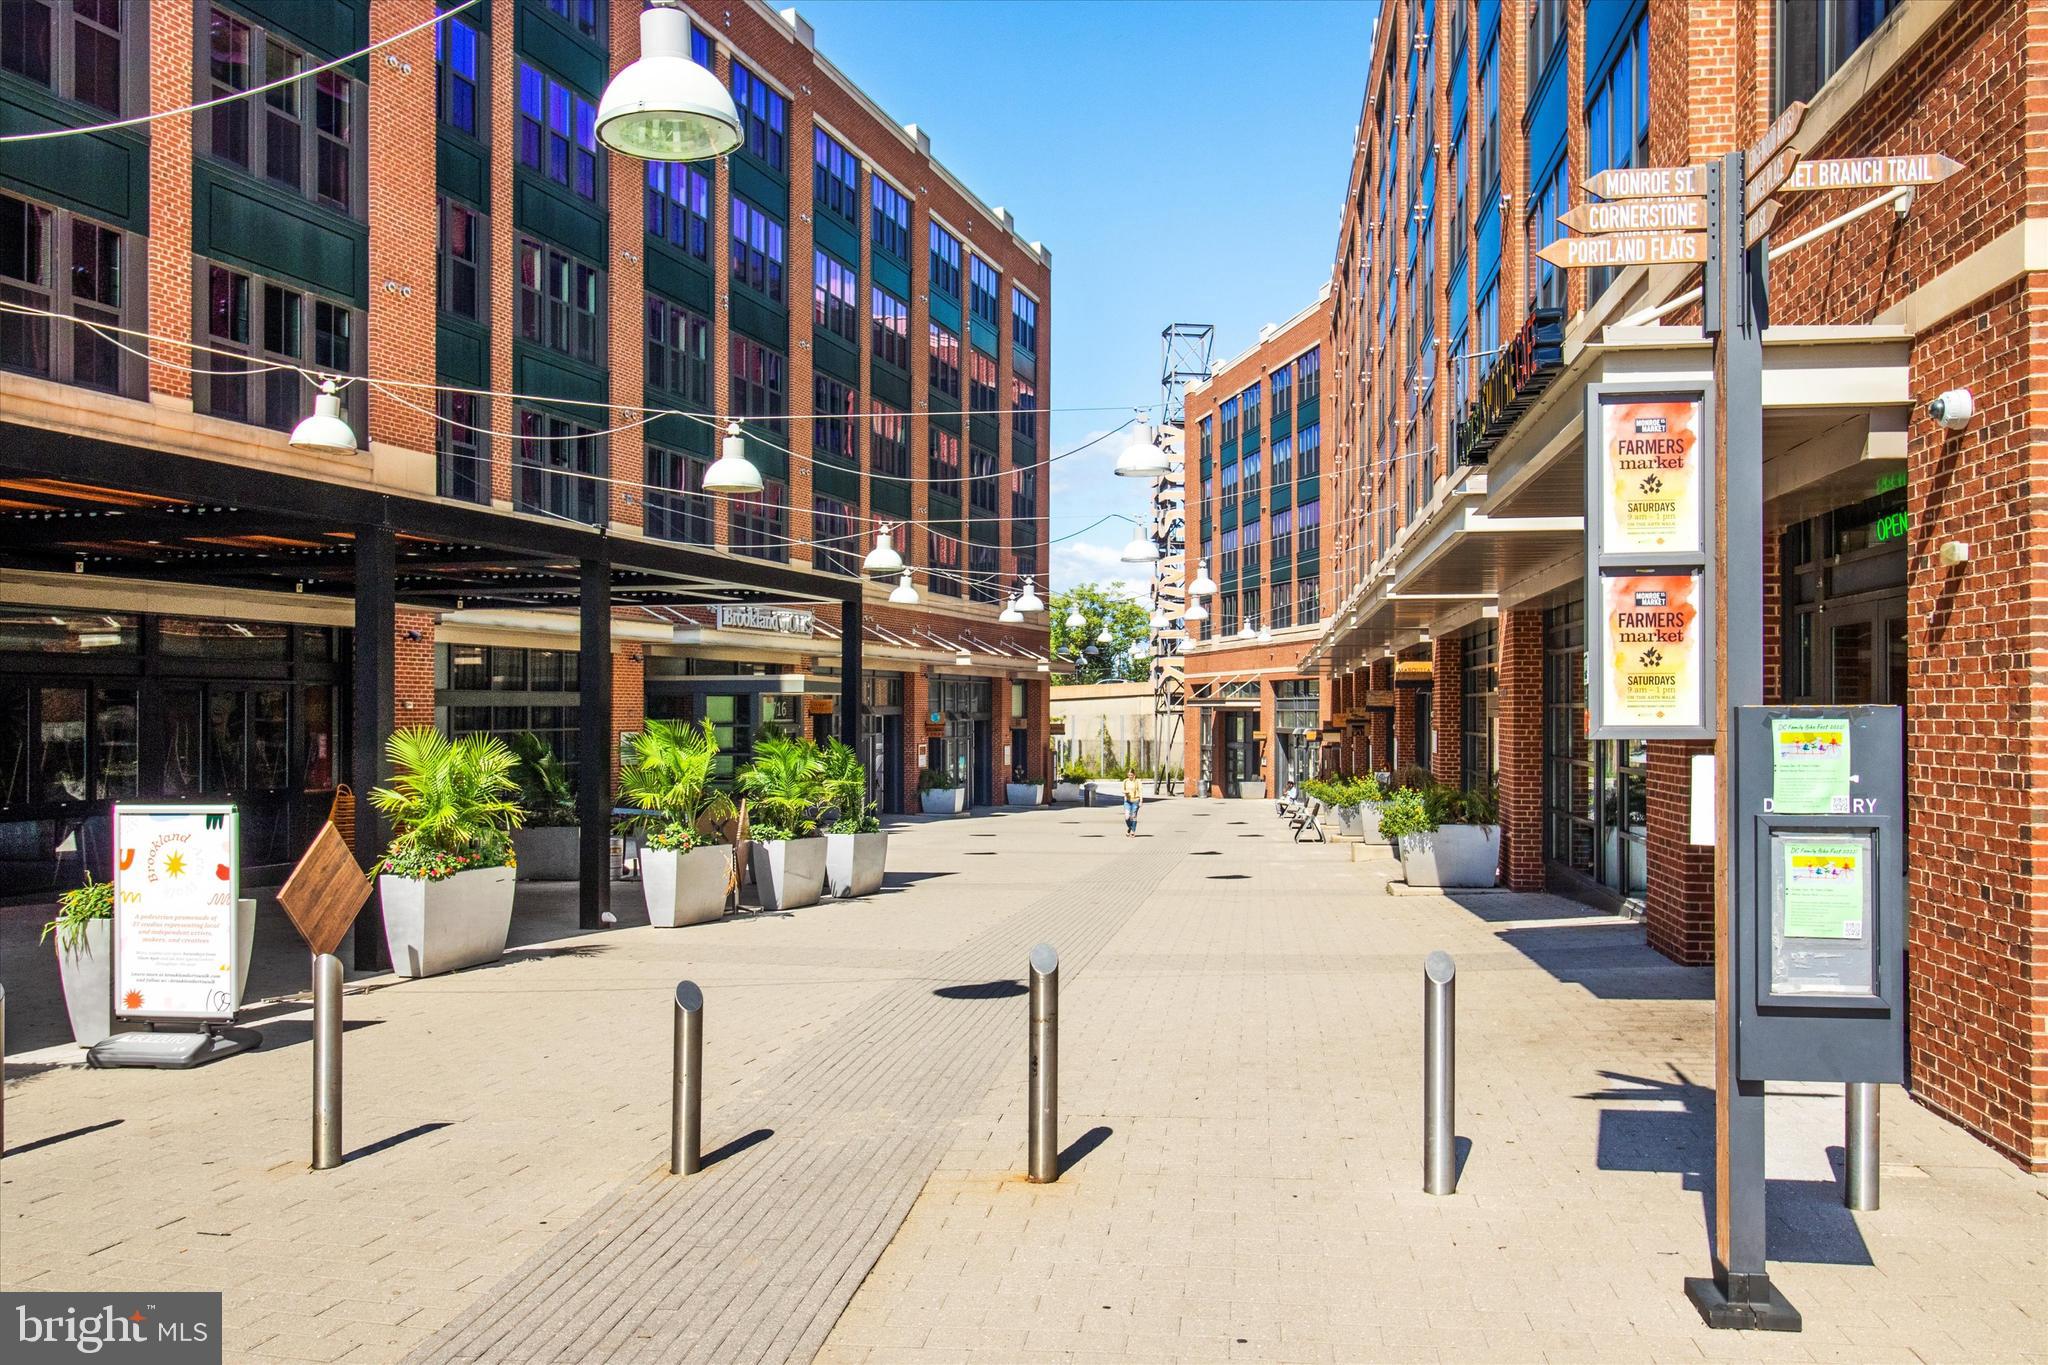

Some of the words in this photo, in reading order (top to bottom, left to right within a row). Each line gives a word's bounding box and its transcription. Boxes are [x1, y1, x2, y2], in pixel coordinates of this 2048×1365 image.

[1606, 171, 1670, 196] MONROE
[1675, 169, 1695, 194] ST.
[1818, 159, 1883, 186] BRANCH
[1887, 157, 1933, 182] TRAIL
[1589, 202, 1697, 230] CORNERSTONE
[1568, 239, 1646, 265] PORTLAND
[1651, 236, 1696, 261] FLATS
[1618, 438, 1685, 455] FARMERS
[1619, 455, 1684, 469] market
[1627, 502, 1676, 512] SATURDAYS
[1876, 511, 1908, 541] OPEN
[1618, 612, 1685, 628] FARMERS
[1619, 628, 1684, 642] market
[1627, 676, 1676, 686] SATURDAYS
[147, 832, 192, 883] Brookland
